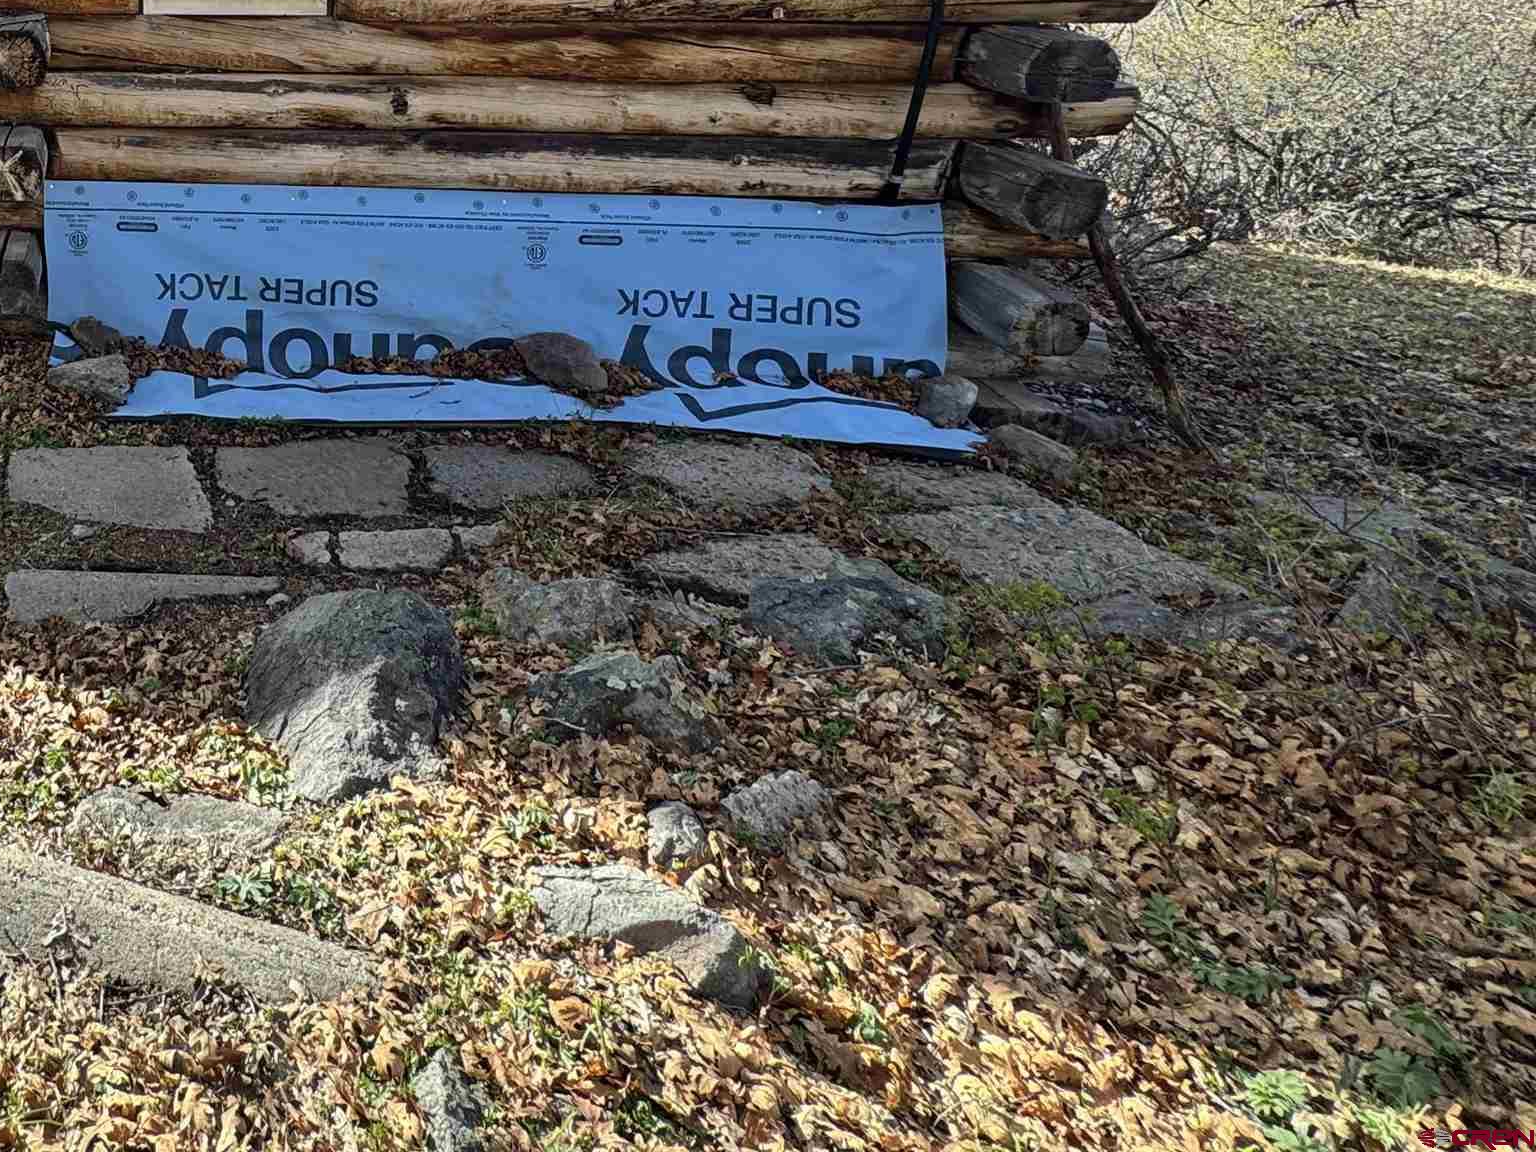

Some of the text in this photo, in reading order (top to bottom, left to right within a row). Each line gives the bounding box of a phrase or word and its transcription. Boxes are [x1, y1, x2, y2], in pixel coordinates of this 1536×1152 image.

[155, 273, 379, 307] SUPER TACK
[616, 288, 861, 328] SUPER TACK
